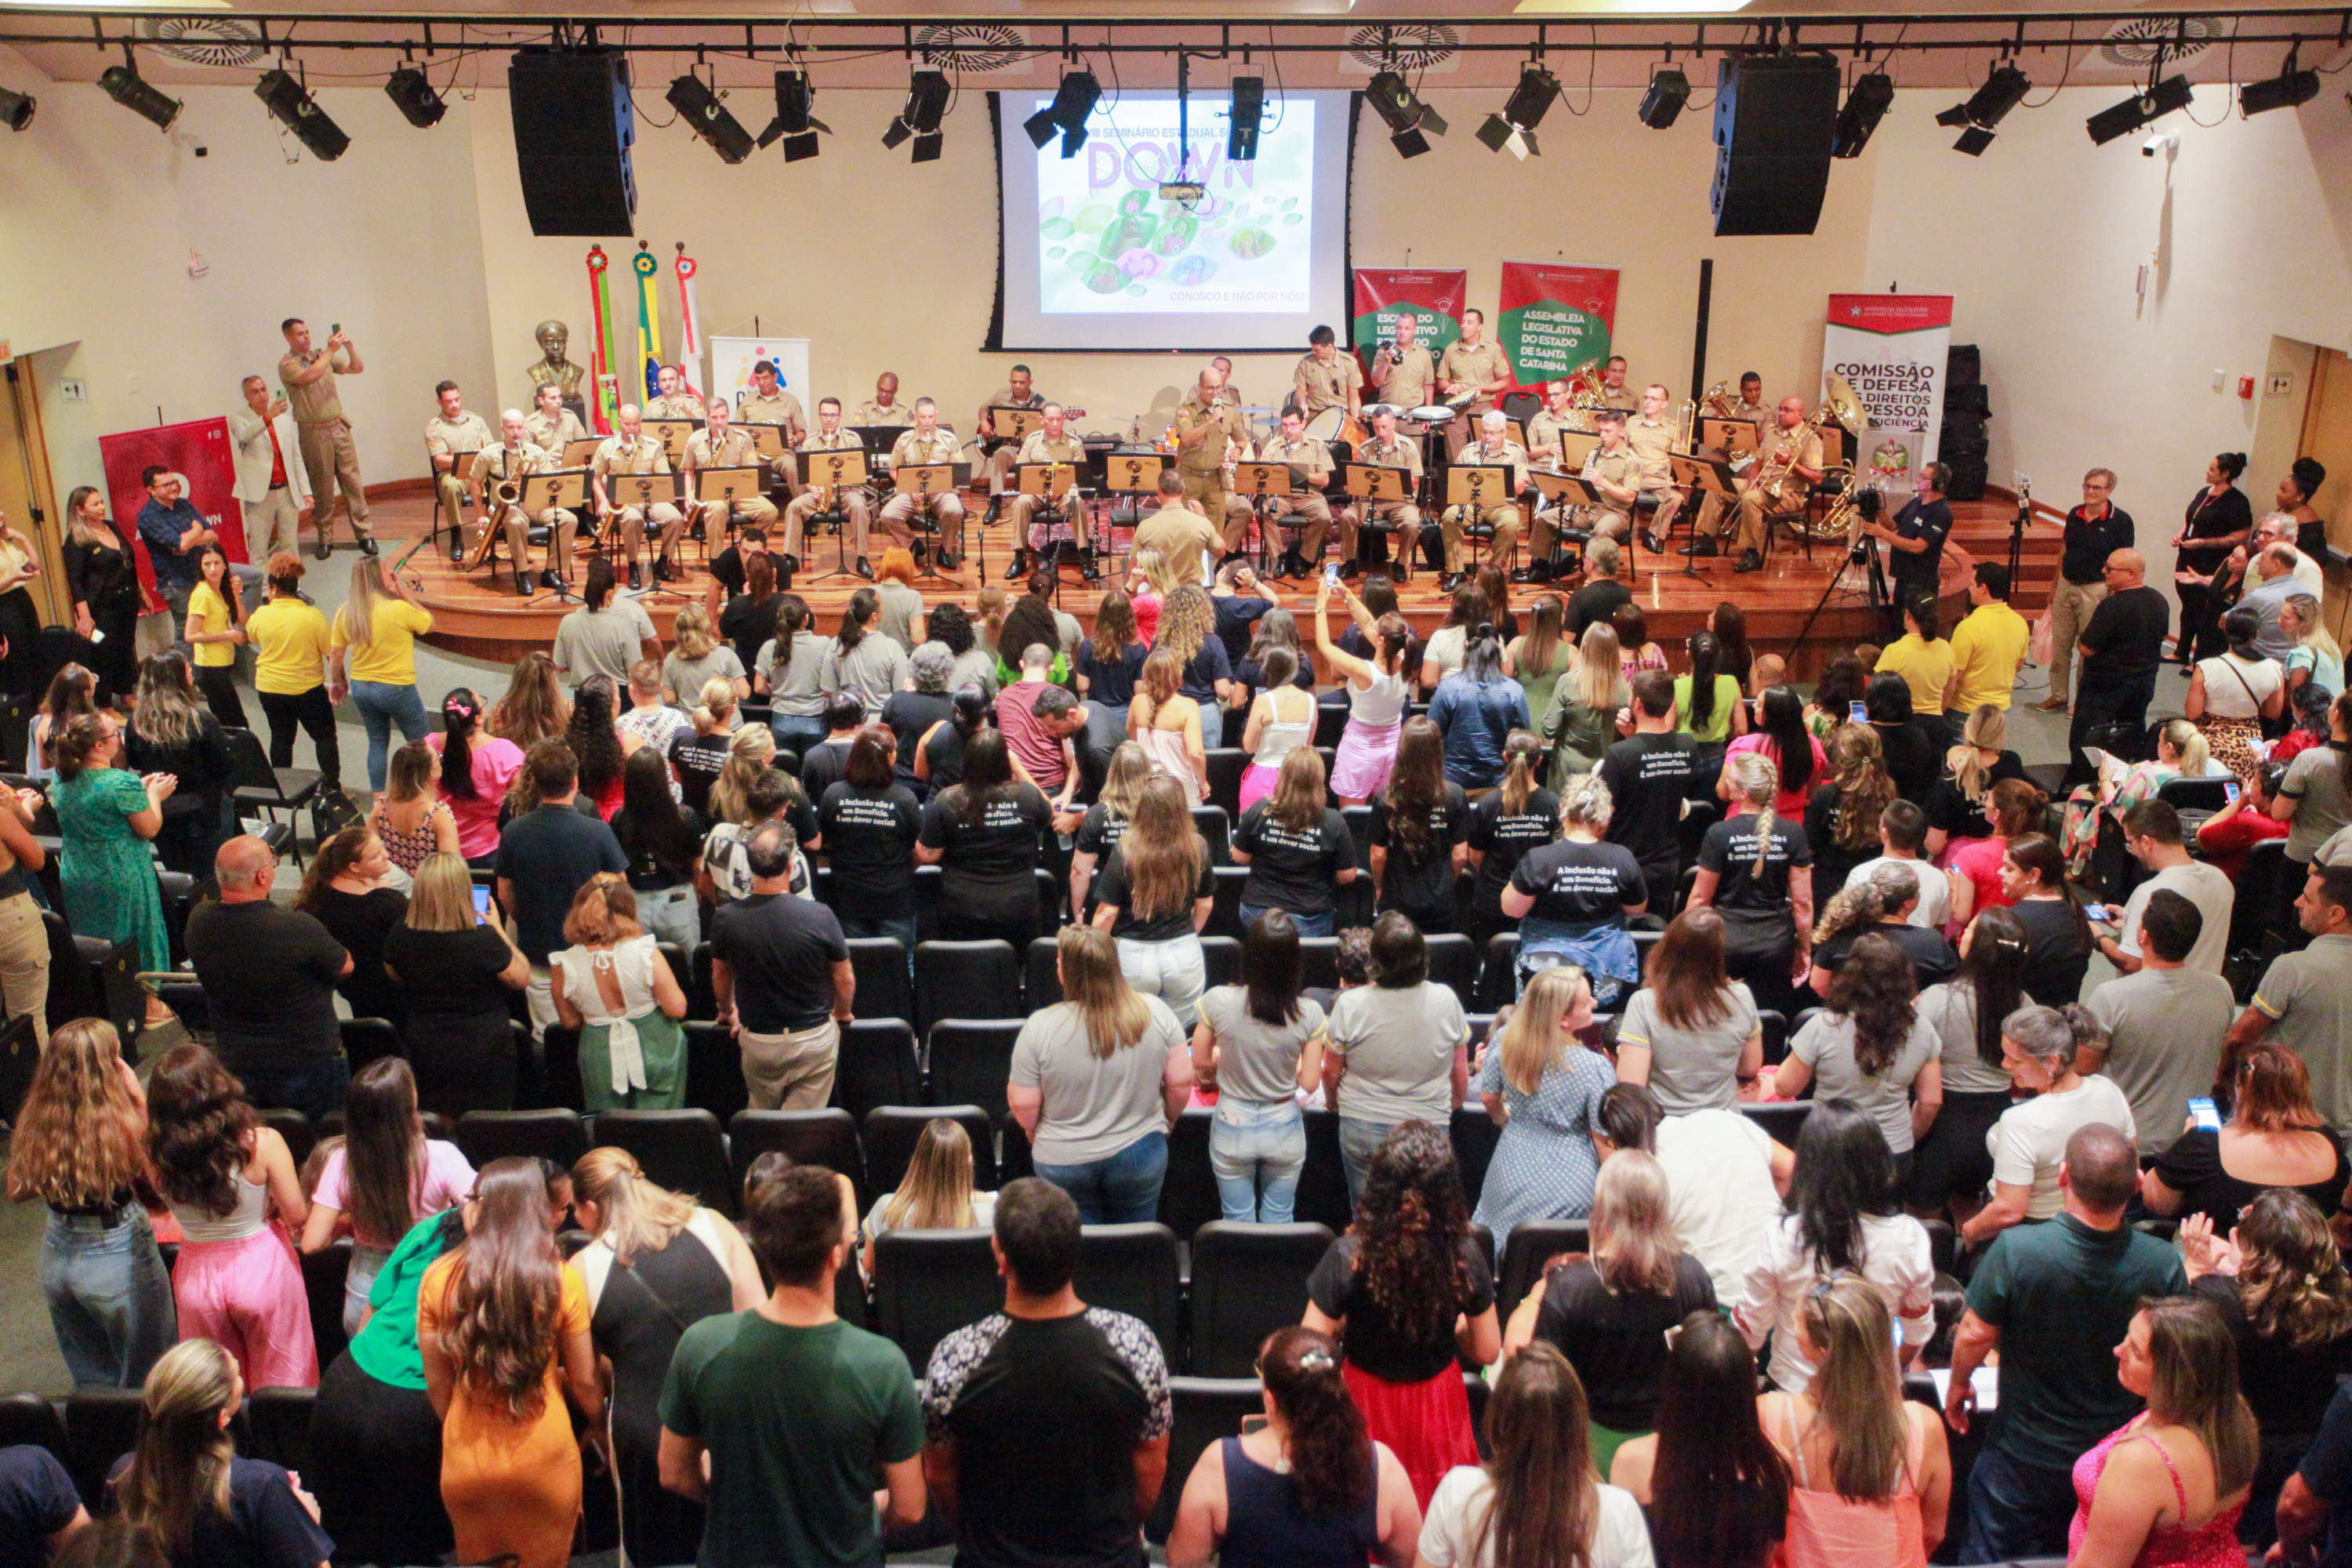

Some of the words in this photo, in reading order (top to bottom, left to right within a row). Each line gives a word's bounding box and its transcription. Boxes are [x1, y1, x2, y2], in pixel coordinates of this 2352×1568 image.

[1102, 125, 1160, 138] SEMINÁRIO
[1088, 141, 1254, 190] DOWN
[1170, 292, 1221, 302] CONOSCO
[1223, 292, 1230, 302] E
[1232, 290, 1254, 302] NÃO
[1256, 292, 1278, 302] POR
[1280, 289, 1305, 302] NÓS!
[1417, 314, 1433, 323] DO
[1523, 310, 1585, 324] ASSEMBLEIA
[1523, 322, 1582, 336] LEGISLATIVA
[1522, 334, 1538, 343] DO
[1538, 336, 1577, 347] ESTADO
[1520, 347, 1534, 355] DE
[1535, 347, 1567, 359] SANTA
[1519, 358, 1567, 372] CATARINA
[1834, 362, 1934, 379] COMISSÃO
[1863, 379, 1932, 393] DEFESA
[1867, 393, 1931, 405] DIREITOS
[1863, 404, 1929, 418] PESSOA
[1012, 800, 1018, 809] é
[1279, 838, 1298, 847] dever
[1565, 866, 1596, 874] inclusão
[1612, 867, 1617, 877] é
[1553, 883, 1559, 892] É
[1573, 884, 1594, 892] dever
